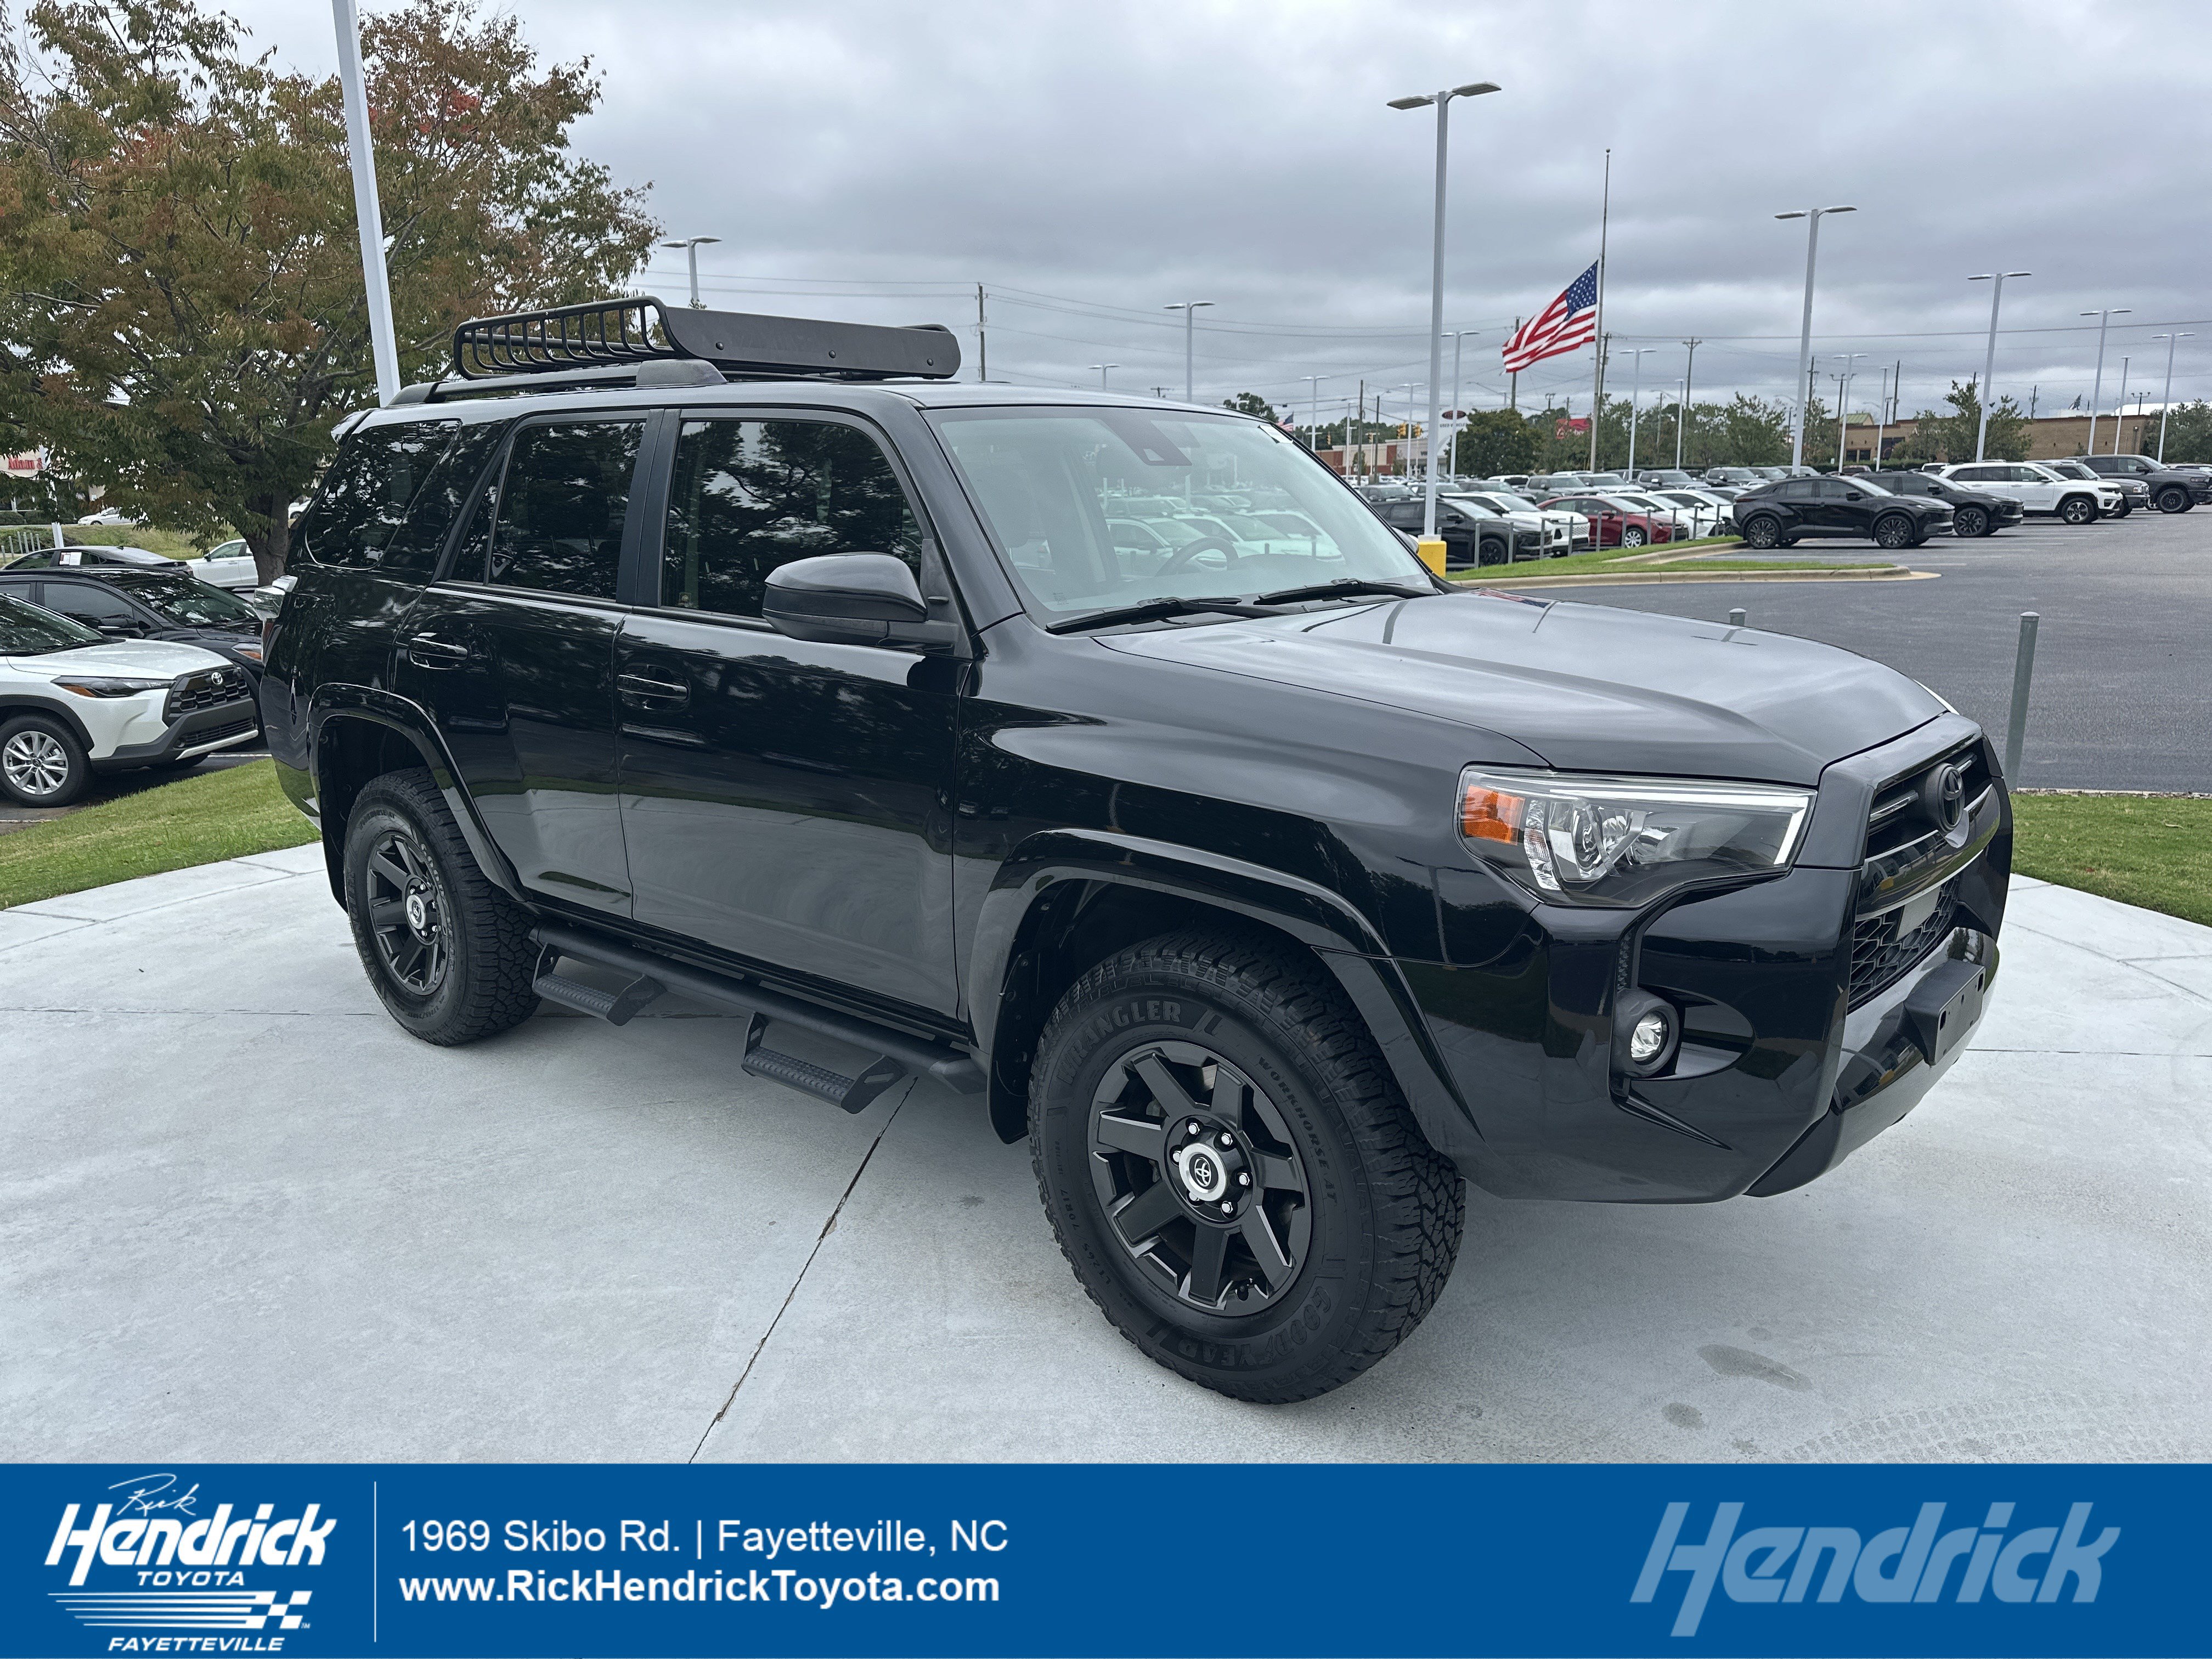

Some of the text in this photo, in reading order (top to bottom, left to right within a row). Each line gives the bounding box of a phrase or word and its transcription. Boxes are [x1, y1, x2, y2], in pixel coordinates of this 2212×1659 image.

[1058, 1000, 1182, 1085] WRANGLER
[1258, 1056, 1338, 1205] WORKHORSE AT
